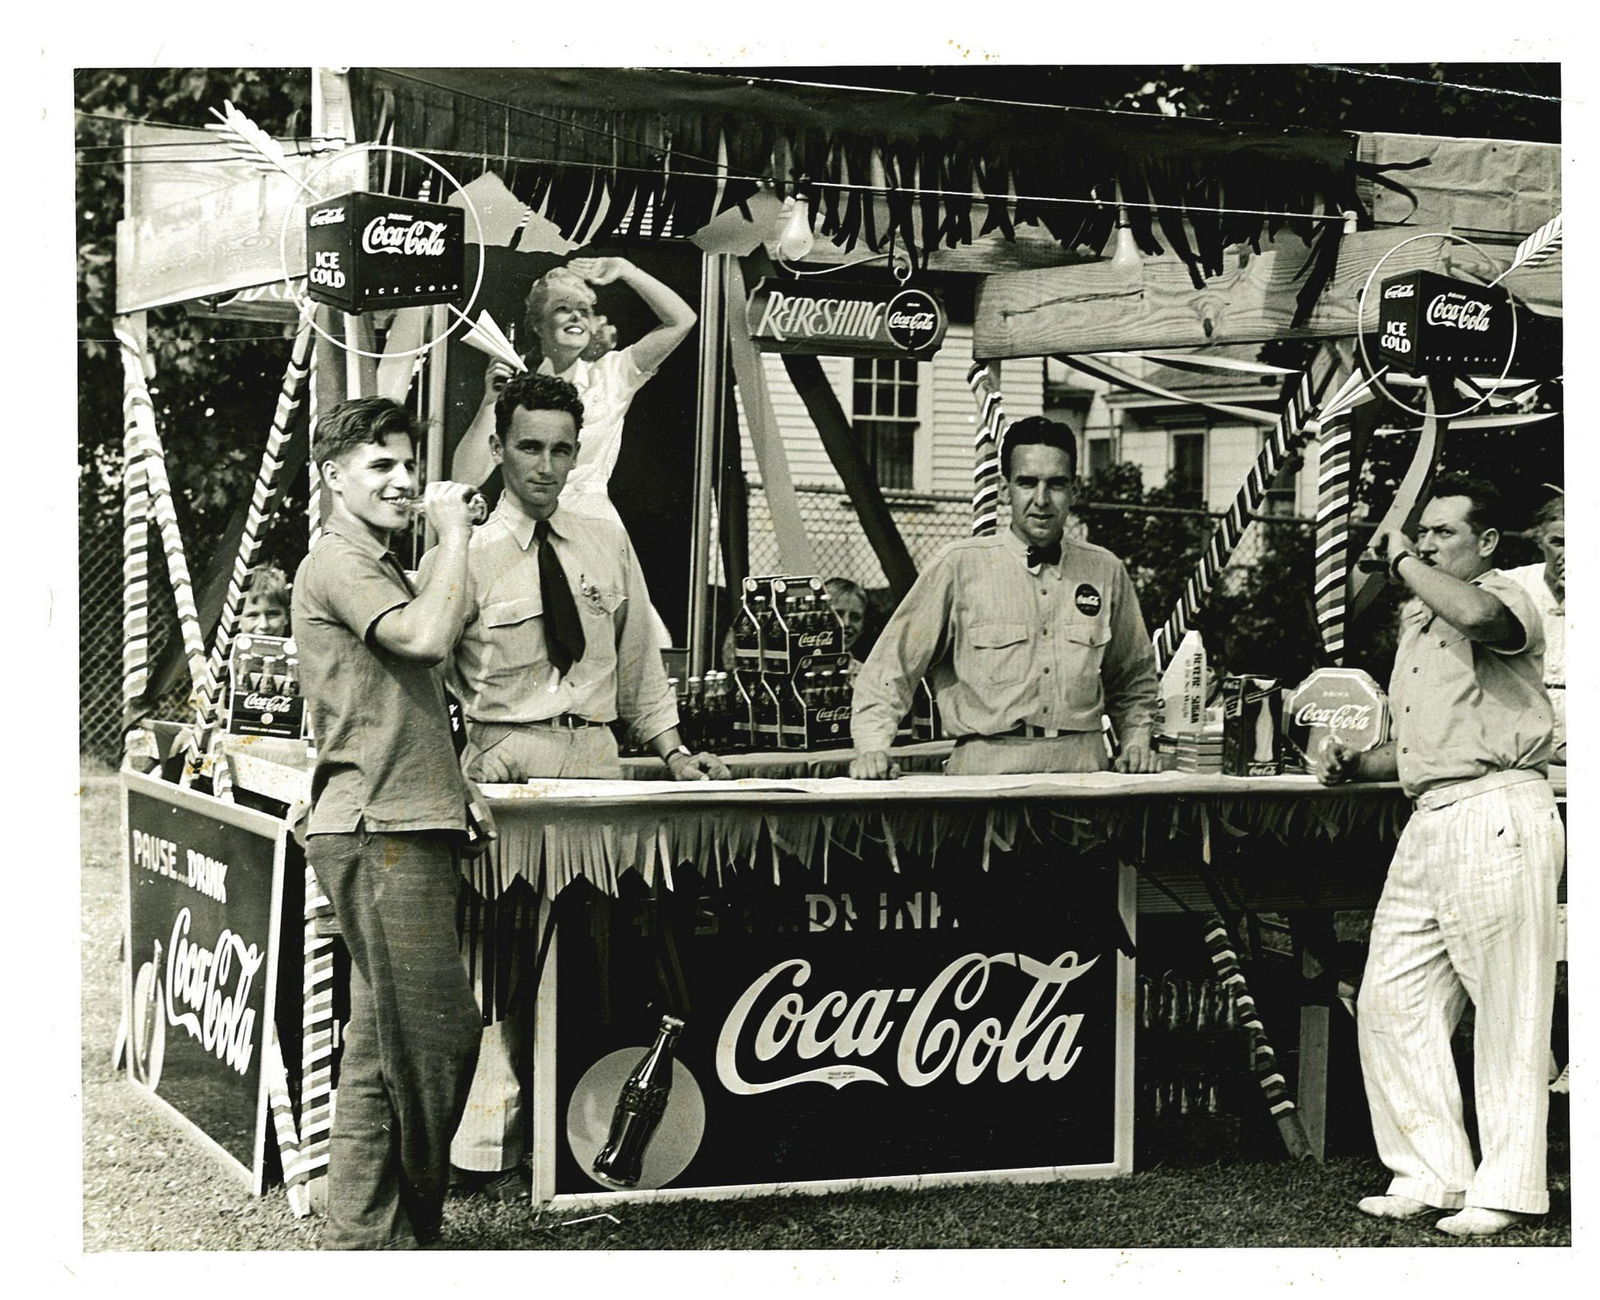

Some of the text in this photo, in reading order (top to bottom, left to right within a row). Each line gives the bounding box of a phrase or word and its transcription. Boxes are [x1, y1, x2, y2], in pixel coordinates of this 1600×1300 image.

[362, 216, 448, 256] Coca-Cola
[315, 251, 340, 270] ICE
[309, 267, 346, 289] COLD
[756, 290, 887, 342] REFRESHING
[888, 311, 936, 331] Coca-Cola
[1426, 294, 1493, 332] Coca-Cola
[1386, 321, 1408, 337] ICE
[1381, 334, 1412, 354] COLD
[798, 631, 834, 648] Coca-Cola
[243, 692, 293, 713] Coca-Cola
[1190, 695, 1201, 724] SUGAR
[1294, 702, 1375, 731] Coca-Cola
[166, 907, 266, 1076] Coca-Cola
[715, 950, 1102, 1096] Coca-Cola
